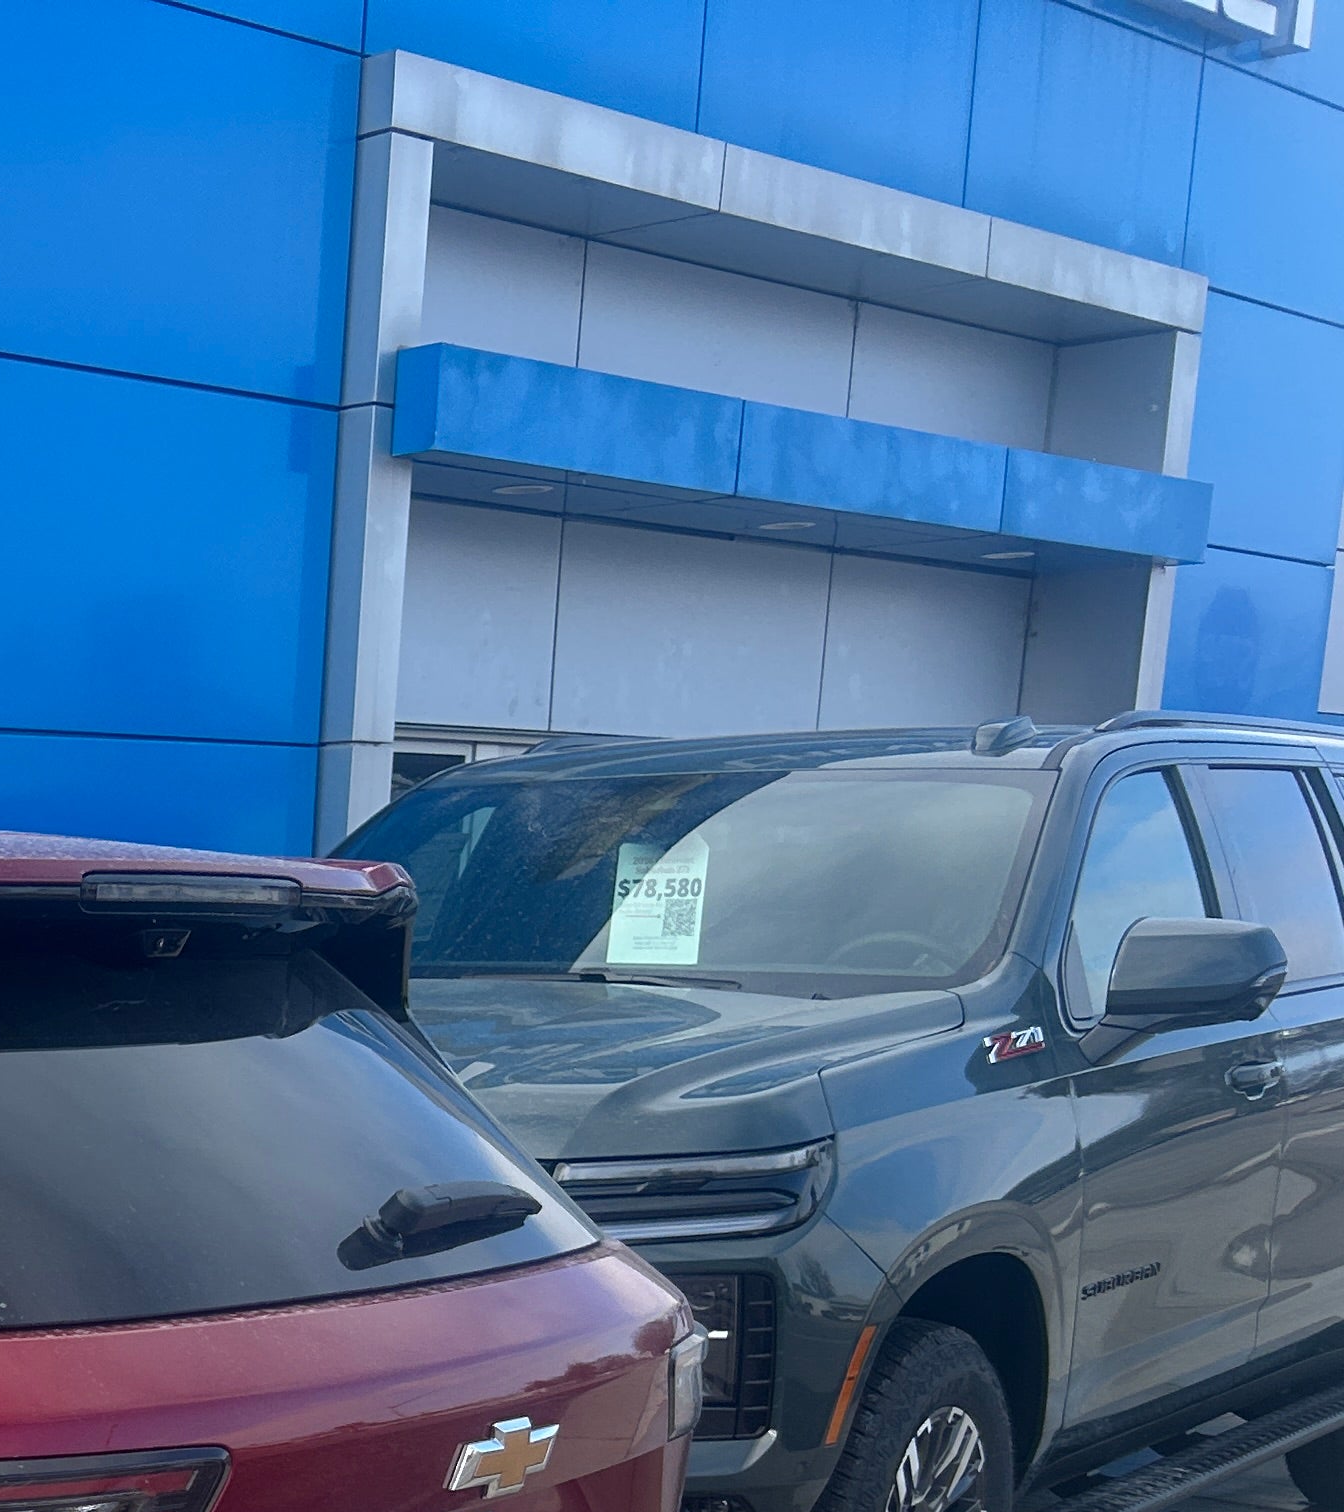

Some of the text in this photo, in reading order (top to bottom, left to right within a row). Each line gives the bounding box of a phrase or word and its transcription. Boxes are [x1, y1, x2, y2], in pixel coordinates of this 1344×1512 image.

[617, 877, 703, 902] $78,580
[982, 1026, 1046, 1065] Z71
[1080, 1261, 1161, 1301] SUBURBAN
